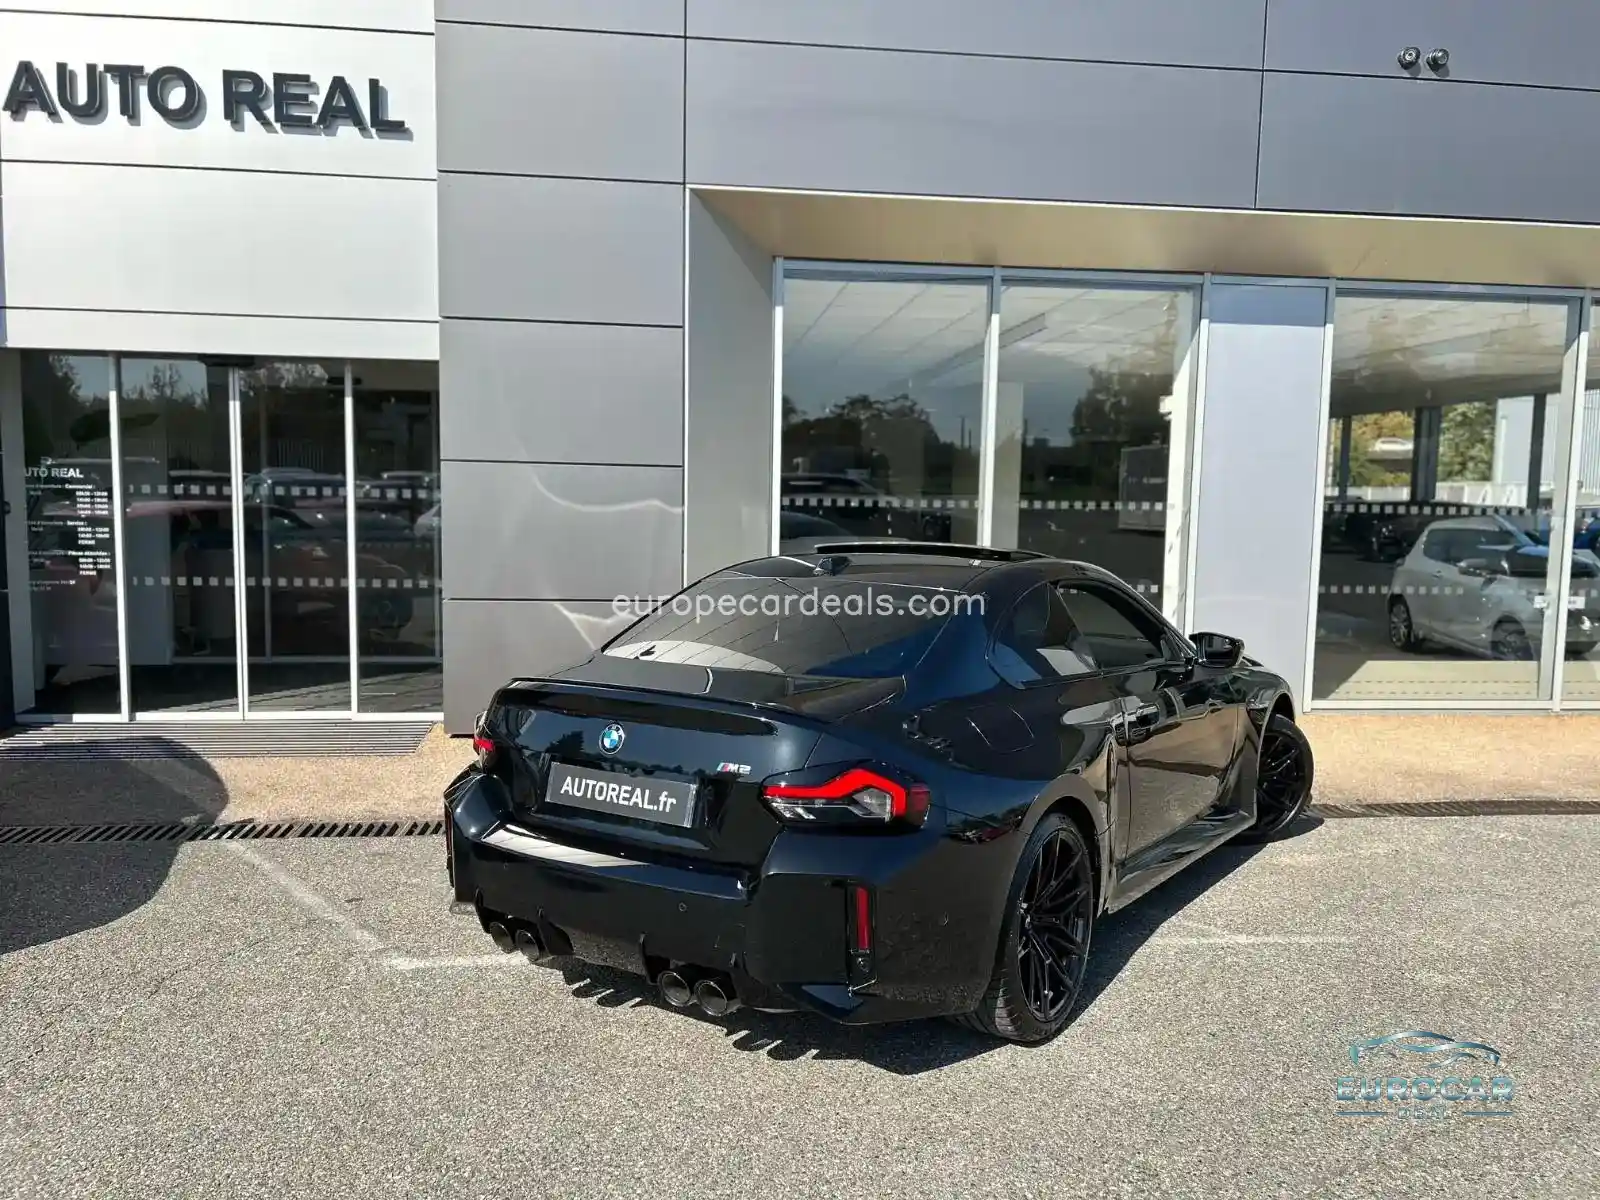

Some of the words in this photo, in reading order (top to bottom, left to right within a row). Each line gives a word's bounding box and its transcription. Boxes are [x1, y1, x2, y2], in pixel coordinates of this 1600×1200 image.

[3, 60, 199, 121] AUTO
[222, 69, 406, 131] REAL
[24, 467, 48, 477] UTO
[51, 467, 84, 478] REAL
[717, 762, 752, 775] M2
[560, 775, 677, 813] AUTOREAL.fr
